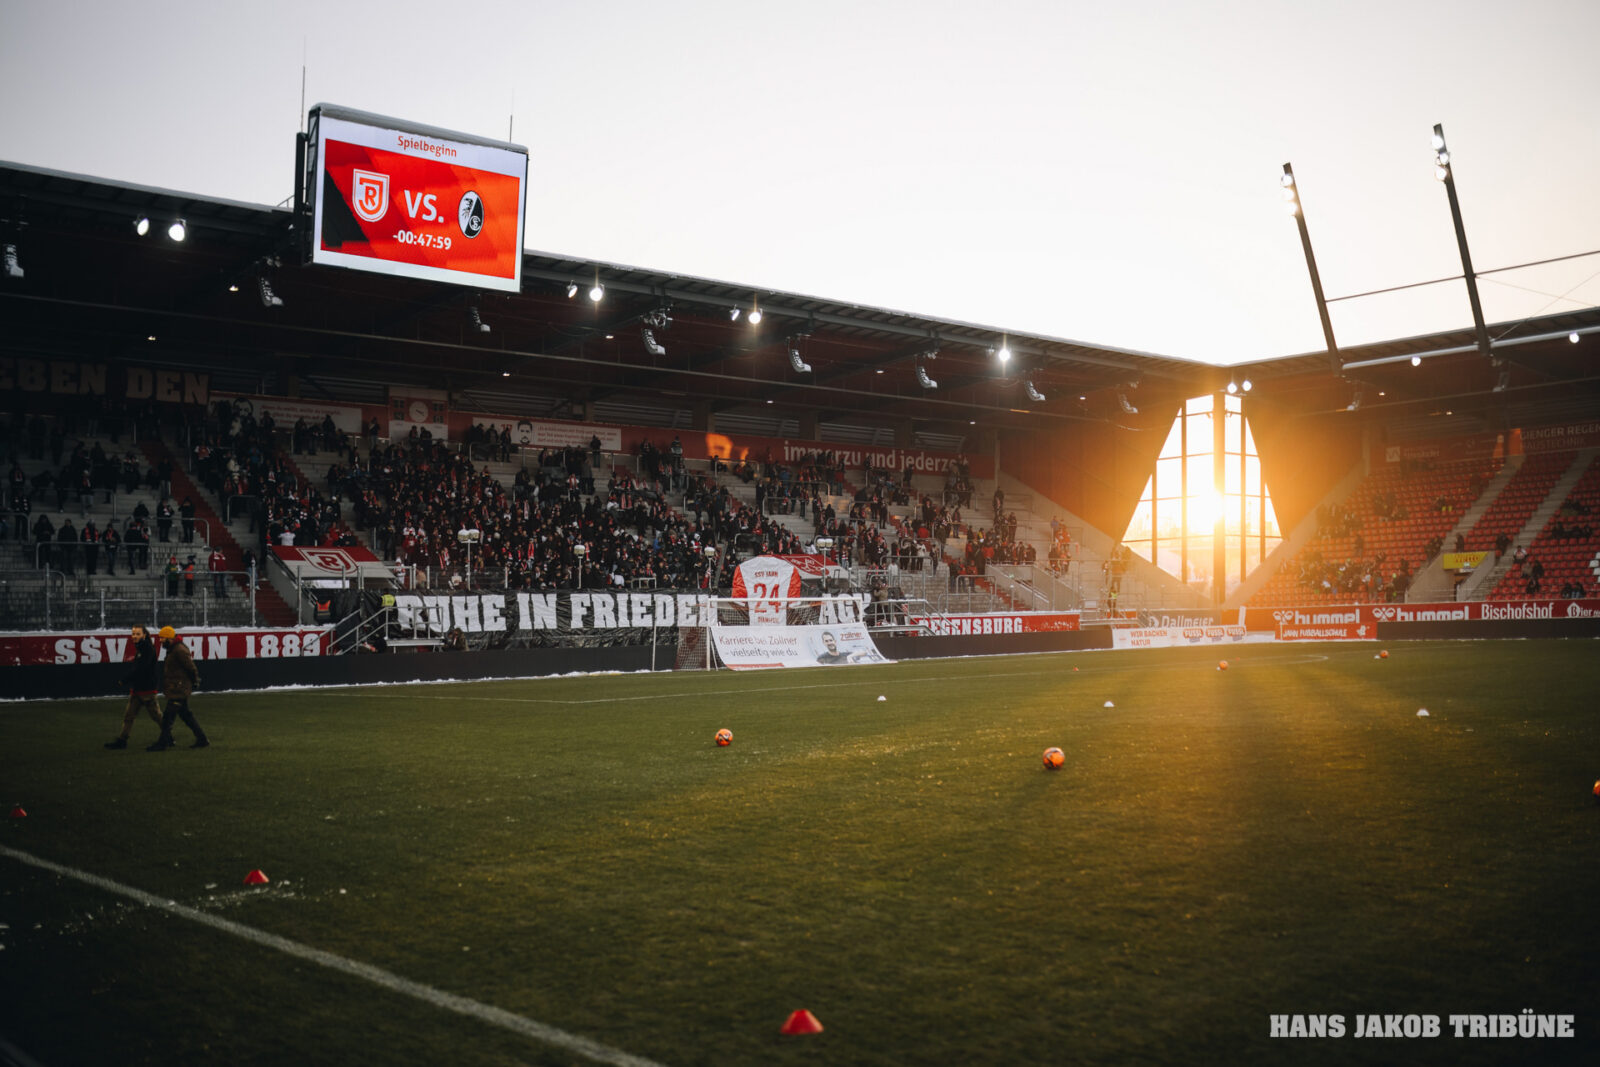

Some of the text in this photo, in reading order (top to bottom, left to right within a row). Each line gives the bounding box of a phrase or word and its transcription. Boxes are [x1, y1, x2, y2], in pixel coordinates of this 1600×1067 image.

[397, 135, 457, 158] Spielbeginn
[404, 189, 445, 223] VS.
[392, 229, 452, 250] -00:47:59
[125, 367, 210, 405] DEN
[784, 440, 861, 466] immrzu
[753, 583, 781, 613] 24
[395, 594, 507, 633] RUHE
[517, 593, 558, 630] IN
[570, 593, 719, 629] FRIEDEN
[1295, 608, 1360, 625] hummel
[1397, 606, 1469, 622] hummel
[1481, 602, 1554, 620] Bischofshof
[54, 637, 129, 665] SSV
[245, 633, 321, 658] 1889
[718, 634, 754, 647] Karriere
[768, 635, 798, 646] Zollner
[770, 649, 784, 657] wie
[785, 648, 798, 657] du
